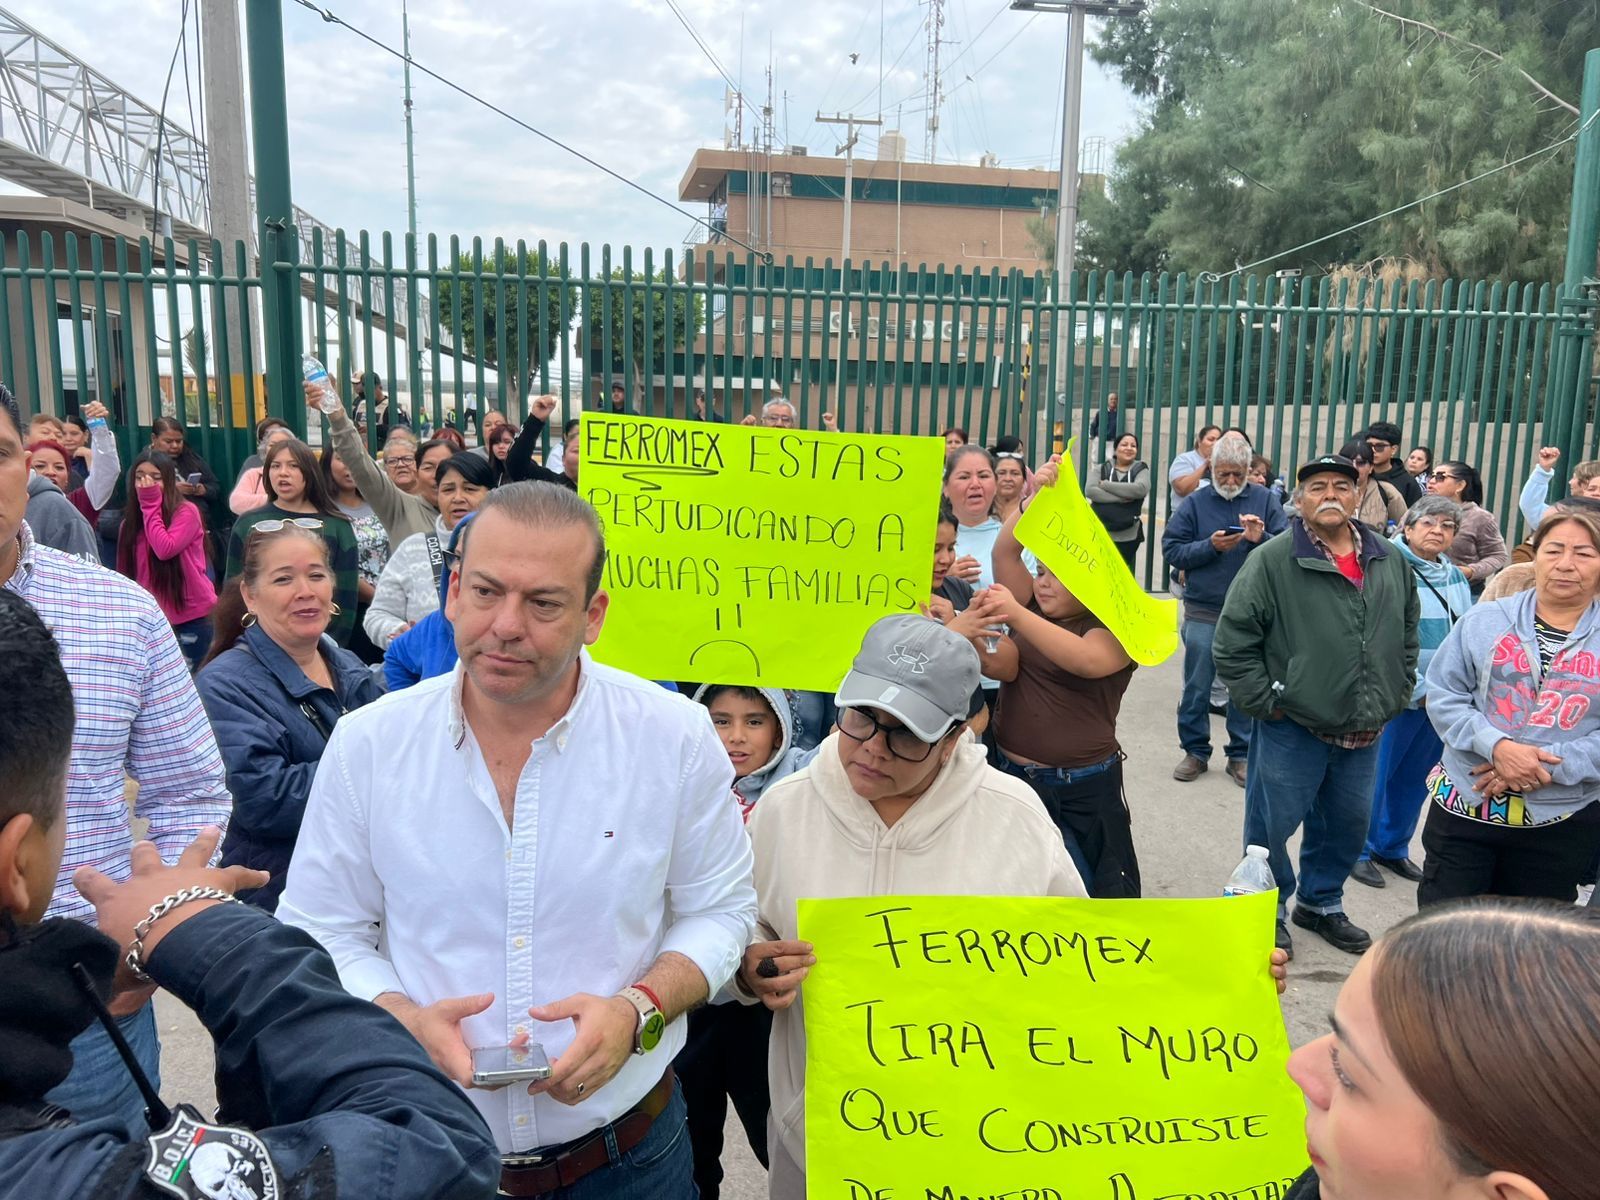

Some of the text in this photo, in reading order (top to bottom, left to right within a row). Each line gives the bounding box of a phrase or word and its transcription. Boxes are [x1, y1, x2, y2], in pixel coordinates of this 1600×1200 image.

[586, 420, 904, 482] FERROMEX ESTAS
[587, 487, 905, 552] PERJUDICANDO A
[1040, 511, 1098, 573] DIVIDE
[427, 537, 442, 565] COACH
[734, 565, 917, 610] FAMILIAS
[1527, 690, 1590, 730] 20
[865, 907, 1155, 982] FERROMEX
[845, 1000, 1258, 1080] TIRA EL MURO
[840, 1087, 1269, 1154] QUE CONSTRUISTE
